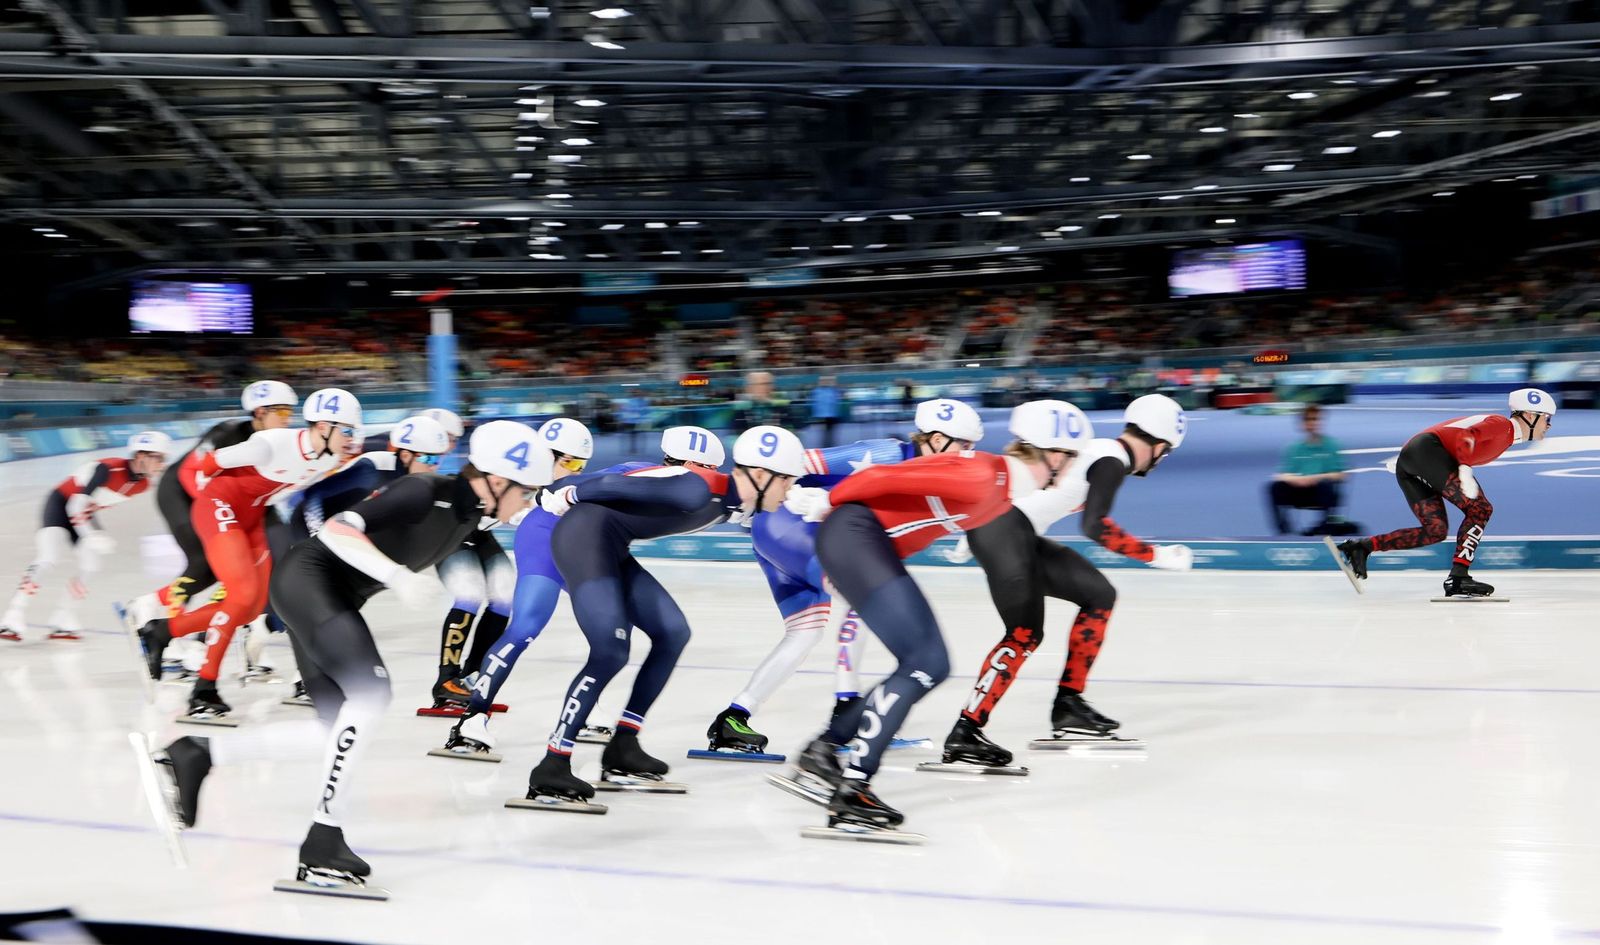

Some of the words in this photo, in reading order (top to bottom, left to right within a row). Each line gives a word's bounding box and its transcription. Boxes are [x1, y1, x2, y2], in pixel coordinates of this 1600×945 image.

[315, 394, 339, 414] 14
[936, 403, 955, 421] 3
[1527, 391, 1542, 405] 6
[400, 424, 414, 444] 2
[545, 422, 563, 441] 8
[1049, 409, 1084, 439] 10
[505, 441, 531, 471] 4
[689, 431, 708, 453] 11
[759, 432, 778, 457] 9
[1457, 524, 1484, 563] DEN
[442, 613, 471, 666] JPN
[473, 643, 515, 699] ITA
[964, 646, 1017, 714] CAN
[549, 675, 597, 750] FRA
[847, 684, 901, 767] NOR
[316, 726, 357, 814] GER
